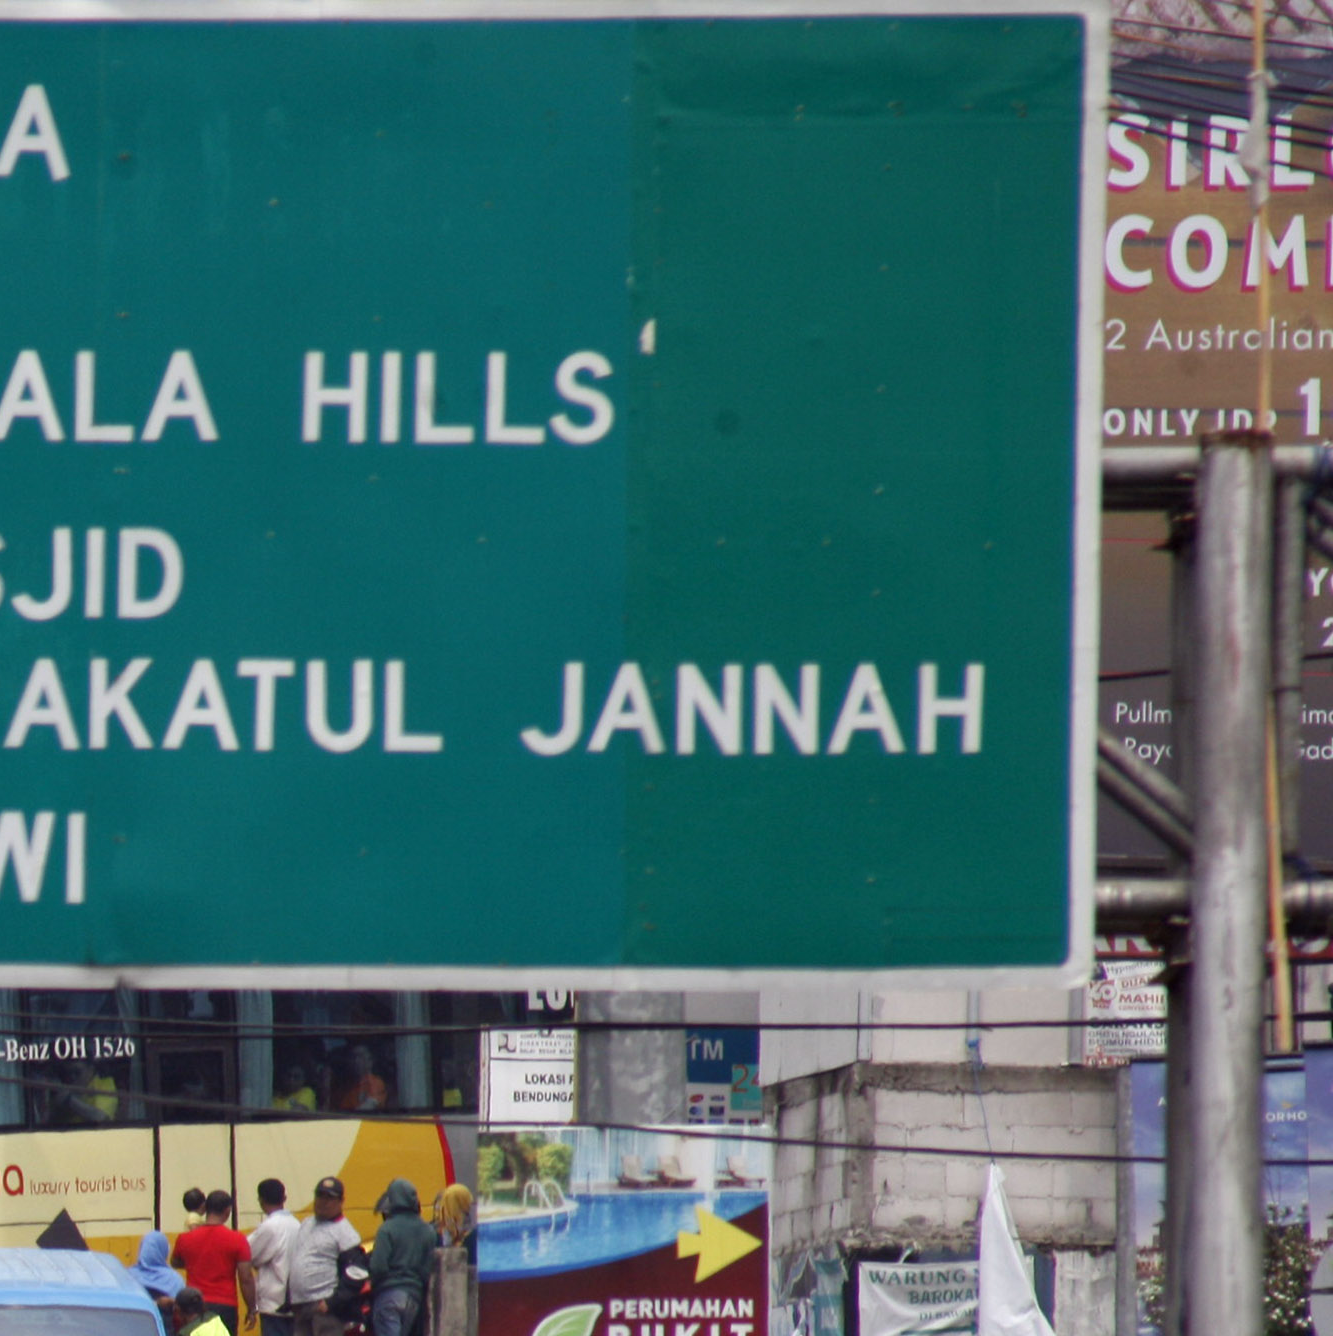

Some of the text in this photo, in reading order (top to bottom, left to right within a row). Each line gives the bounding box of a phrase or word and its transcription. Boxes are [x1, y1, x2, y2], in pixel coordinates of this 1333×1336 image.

[1103, 213, 1333, 291] COM
[1105, 320, 1127, 351] 2
[302, 350, 614, 445] HILLS
[1102, 407, 1200, 438] ONLY
[520, 661, 984, 757] JANNAH
[1115, 700, 1173, 723] Pullm
[54, 1036, 86, 1059] OH
[93, 1036, 136, 1058] 1526
[689, 1038, 724, 1061] TM
[524, 1073, 566, 1085] LOKASI
[513, 1091, 574, 1103] BENDUNGA
[29, 1178, 71, 1196] luxury
[74, 1174, 117, 1193] tourist
[120, 1175, 147, 1191] bus
[868, 1268, 967, 1286] WARUNG
[608, 1299, 754, 1319] PERUMAHAN
